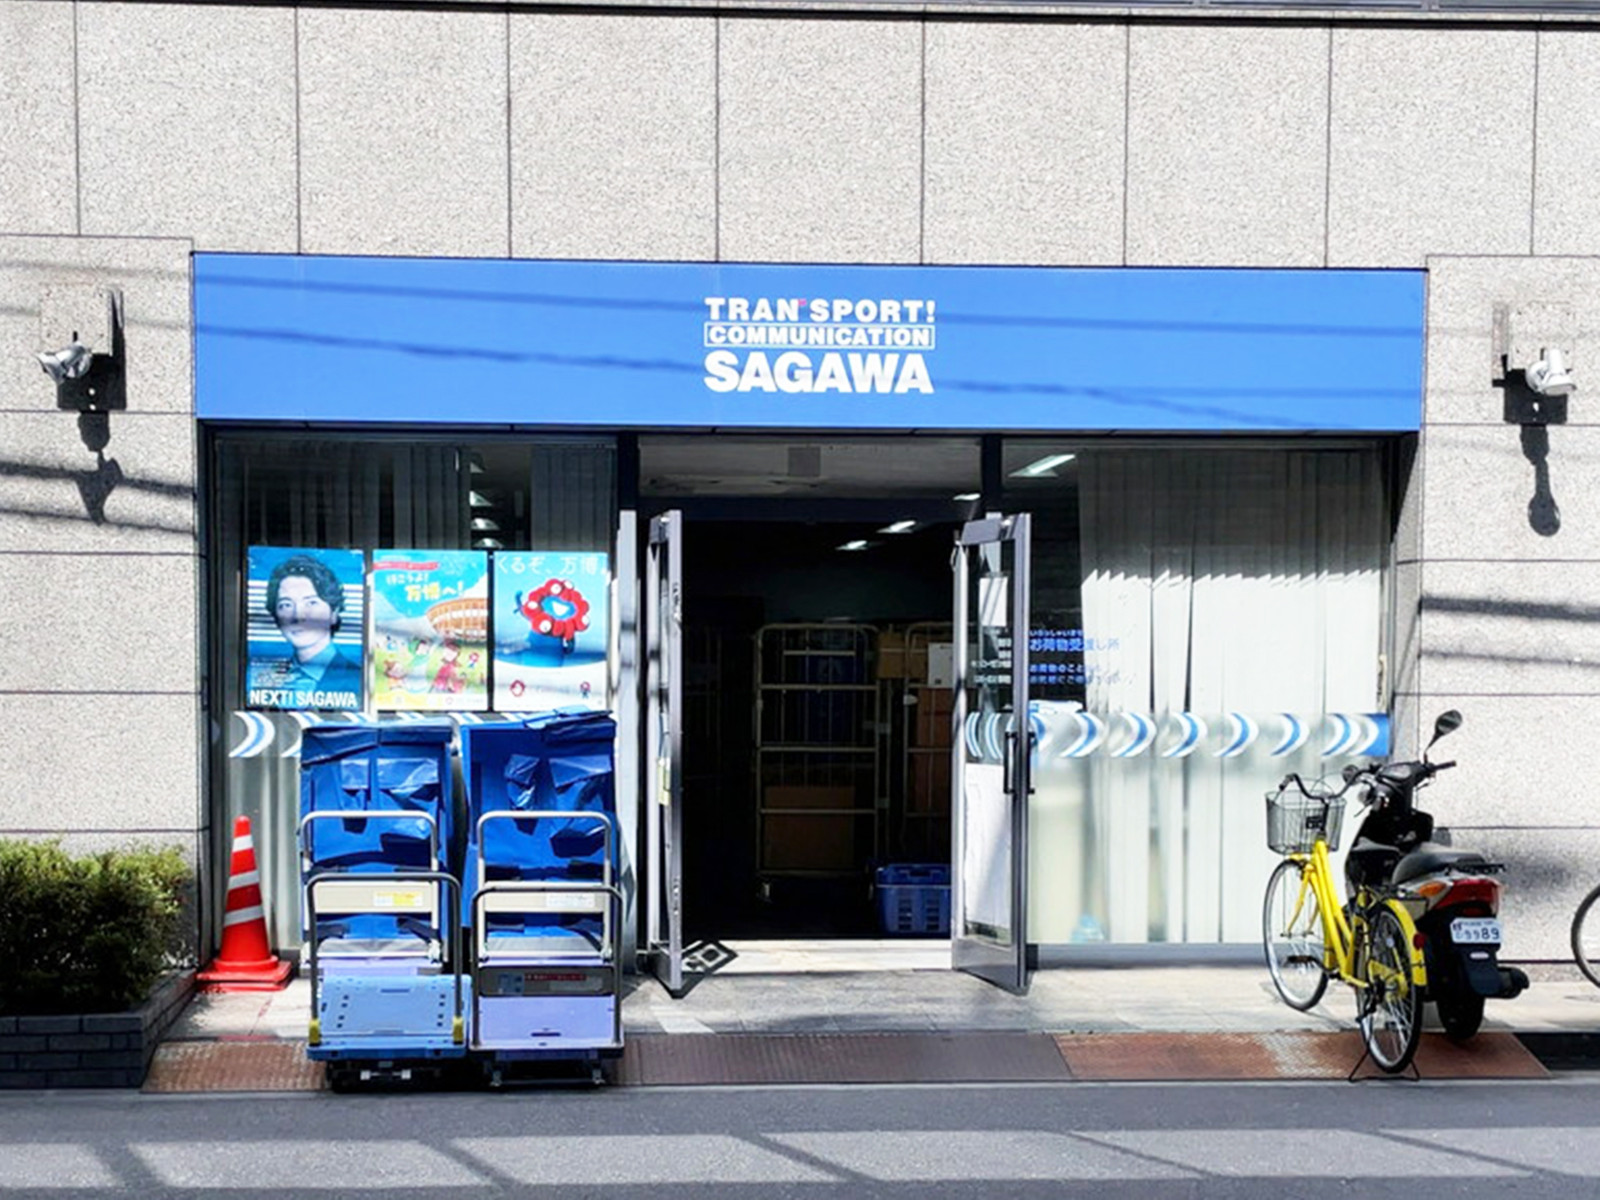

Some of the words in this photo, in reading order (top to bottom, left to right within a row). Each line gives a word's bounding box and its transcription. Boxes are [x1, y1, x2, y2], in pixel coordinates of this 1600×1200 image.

[708, 325, 930, 346] COMMUNICATION
[703, 350, 935, 394] SAGAWA
[295, 690, 358, 708] SAGAWA
